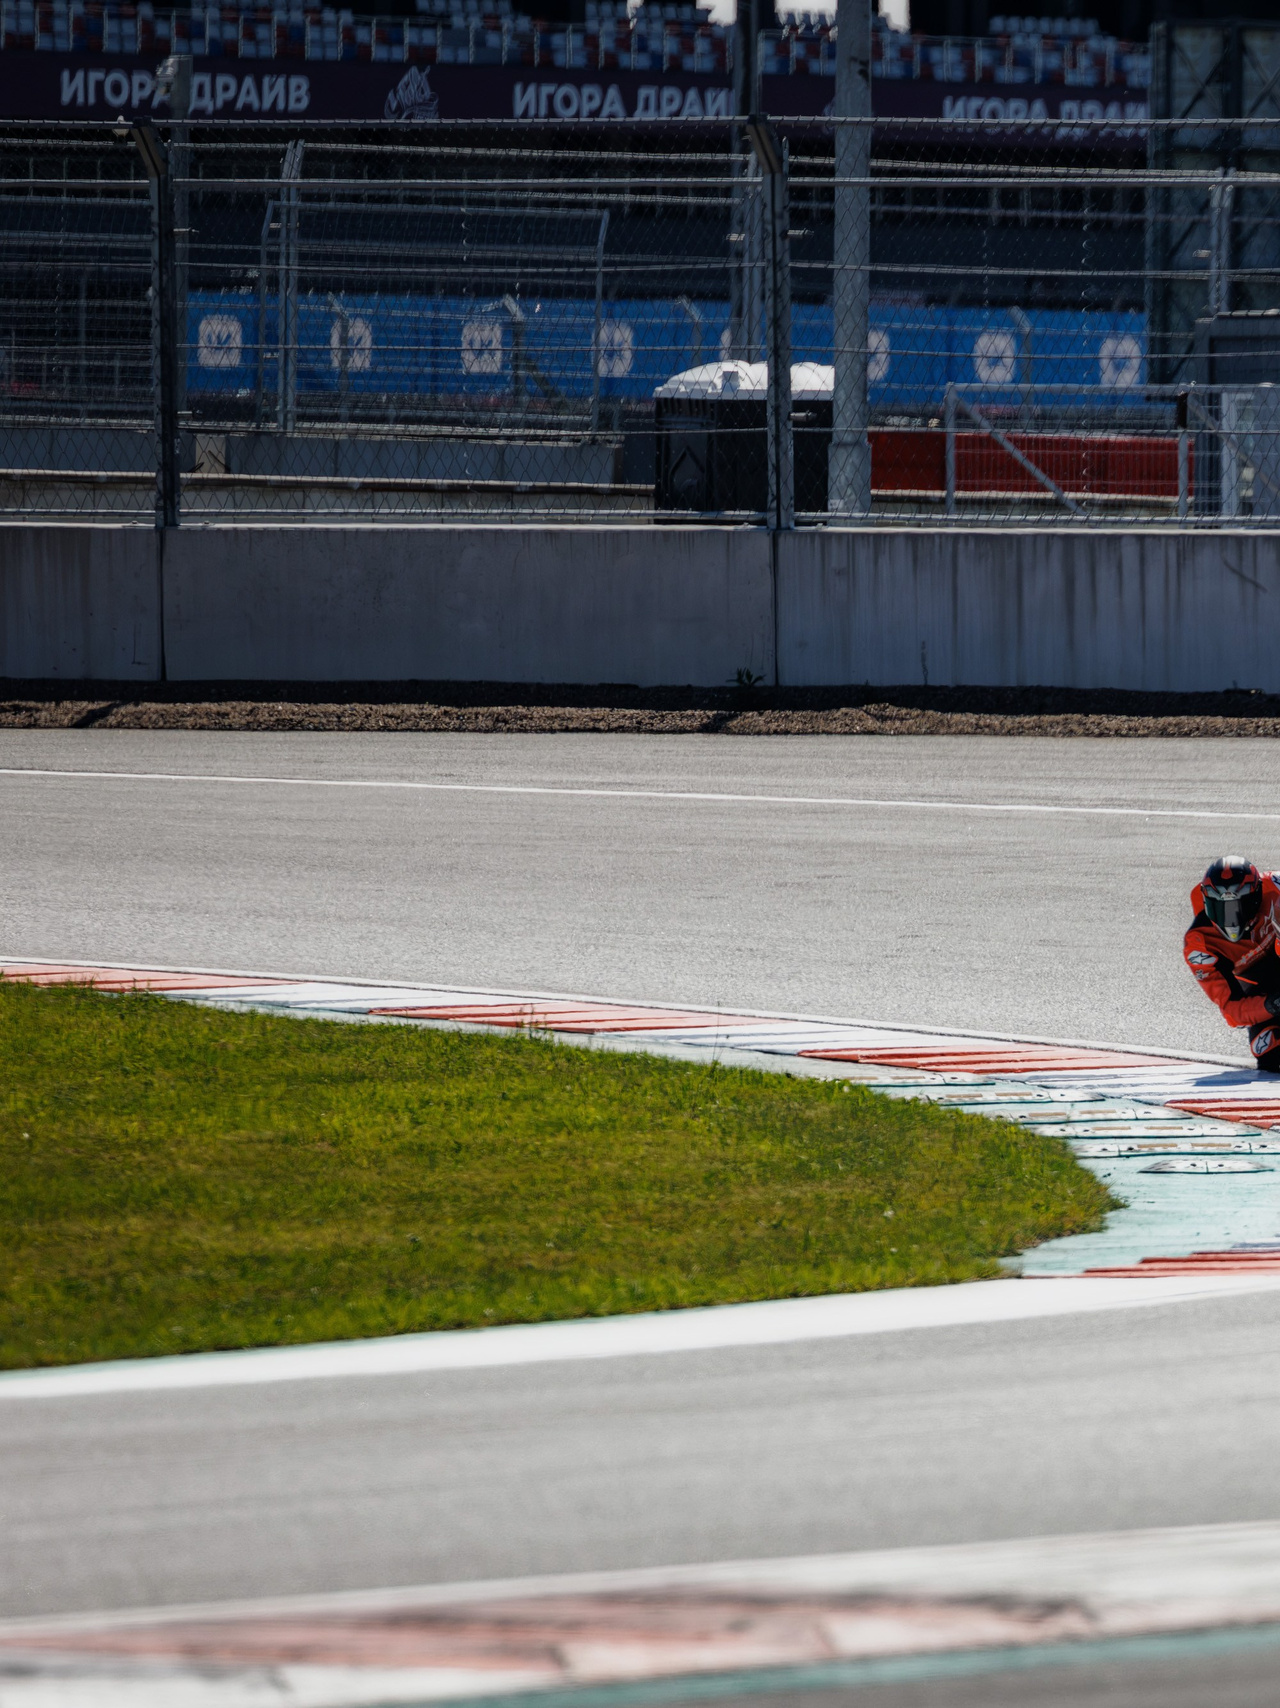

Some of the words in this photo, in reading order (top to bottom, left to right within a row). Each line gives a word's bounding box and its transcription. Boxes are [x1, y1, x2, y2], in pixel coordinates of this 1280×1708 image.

[189, 73, 311, 114] ДРАЙВ
[513, 82, 628, 118] ИГОРА
[634, 85, 740, 119] ДРАЙ
[942, 95, 1049, 135] ИГОРА
